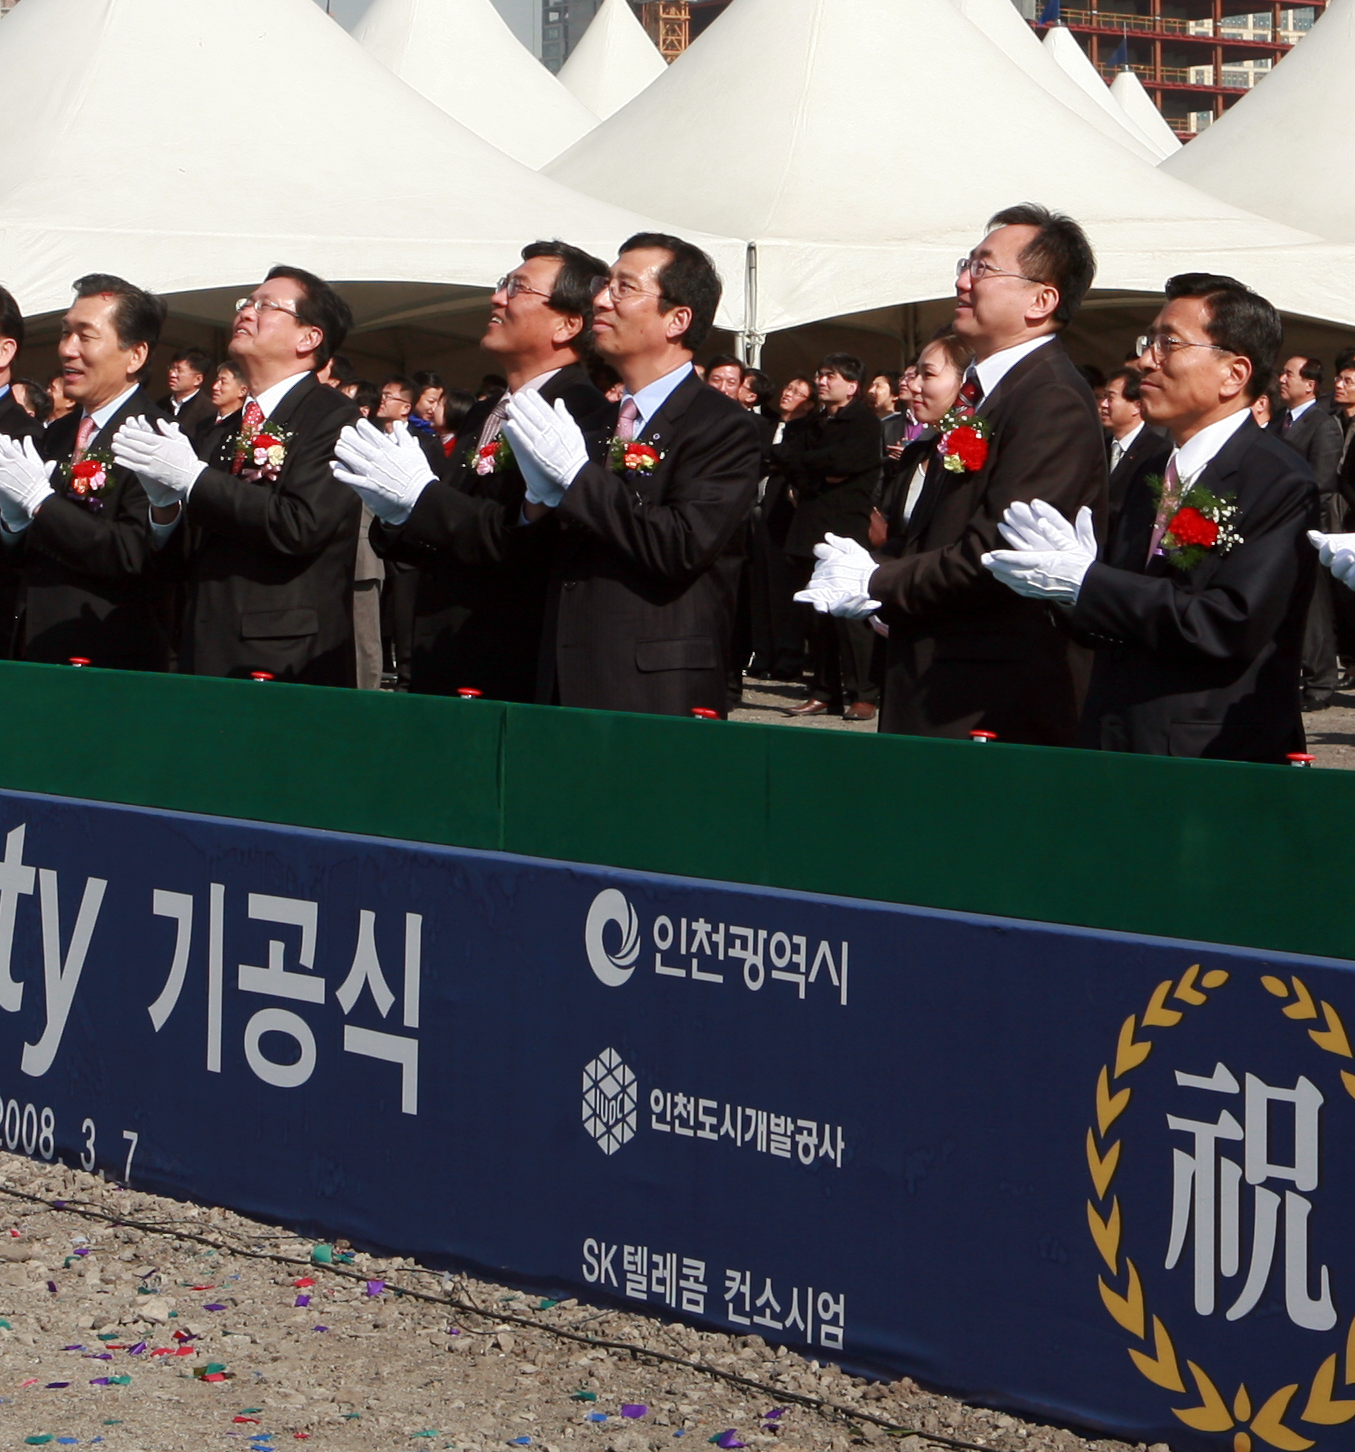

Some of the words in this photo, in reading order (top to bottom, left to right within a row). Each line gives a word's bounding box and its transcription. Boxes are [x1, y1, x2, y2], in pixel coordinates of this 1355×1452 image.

[147, 882, 422, 1115] 기공식
[653, 914, 848, 1006] 인천광역시
[596, 1088, 624, 1126] IUDC
[650, 1088, 845, 1168] 인천도시개발공사
[122, 1130, 138, 1184] 7
[1164, 1060, 1338, 1333] 祝
[724, 1268, 845, 1351] 컨소시엄
